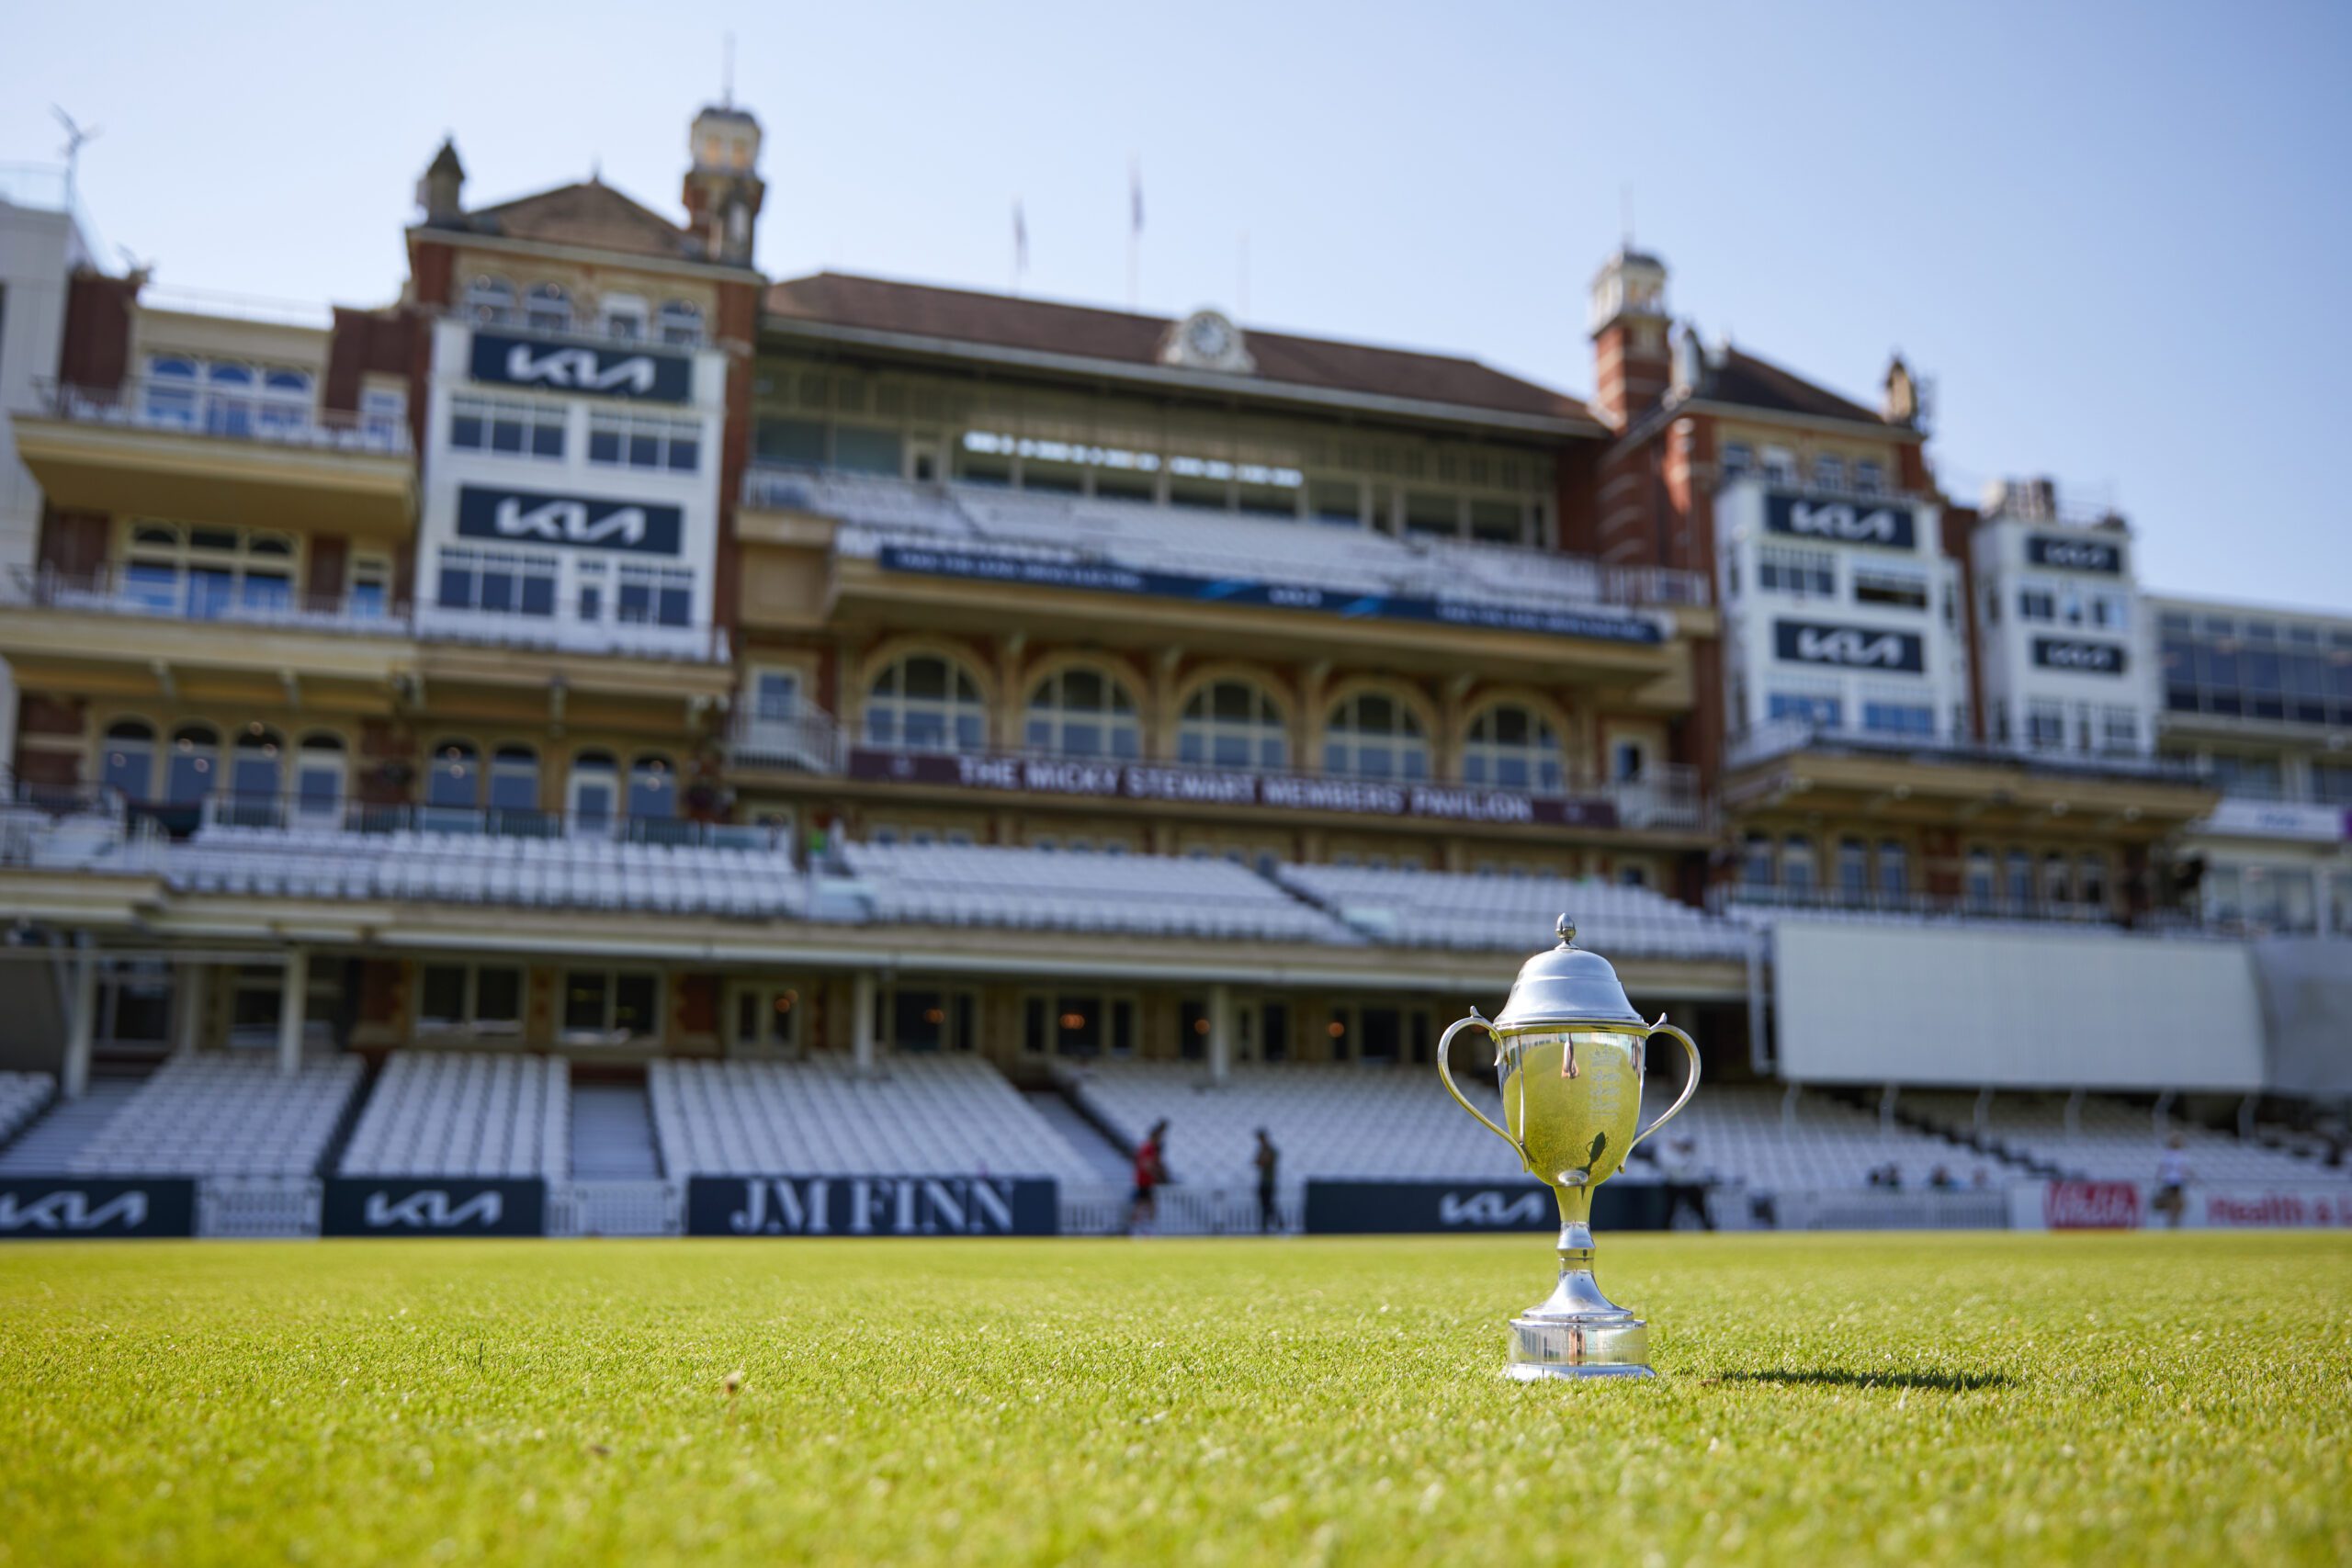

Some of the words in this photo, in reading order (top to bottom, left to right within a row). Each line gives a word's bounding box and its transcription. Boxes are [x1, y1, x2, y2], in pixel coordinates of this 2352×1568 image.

[959, 754, 1019, 789] THE
[1125, 767, 1257, 807] STEWART
[729, 1178, 831, 1235] JM
[847, 1178, 1017, 1235] FINN
